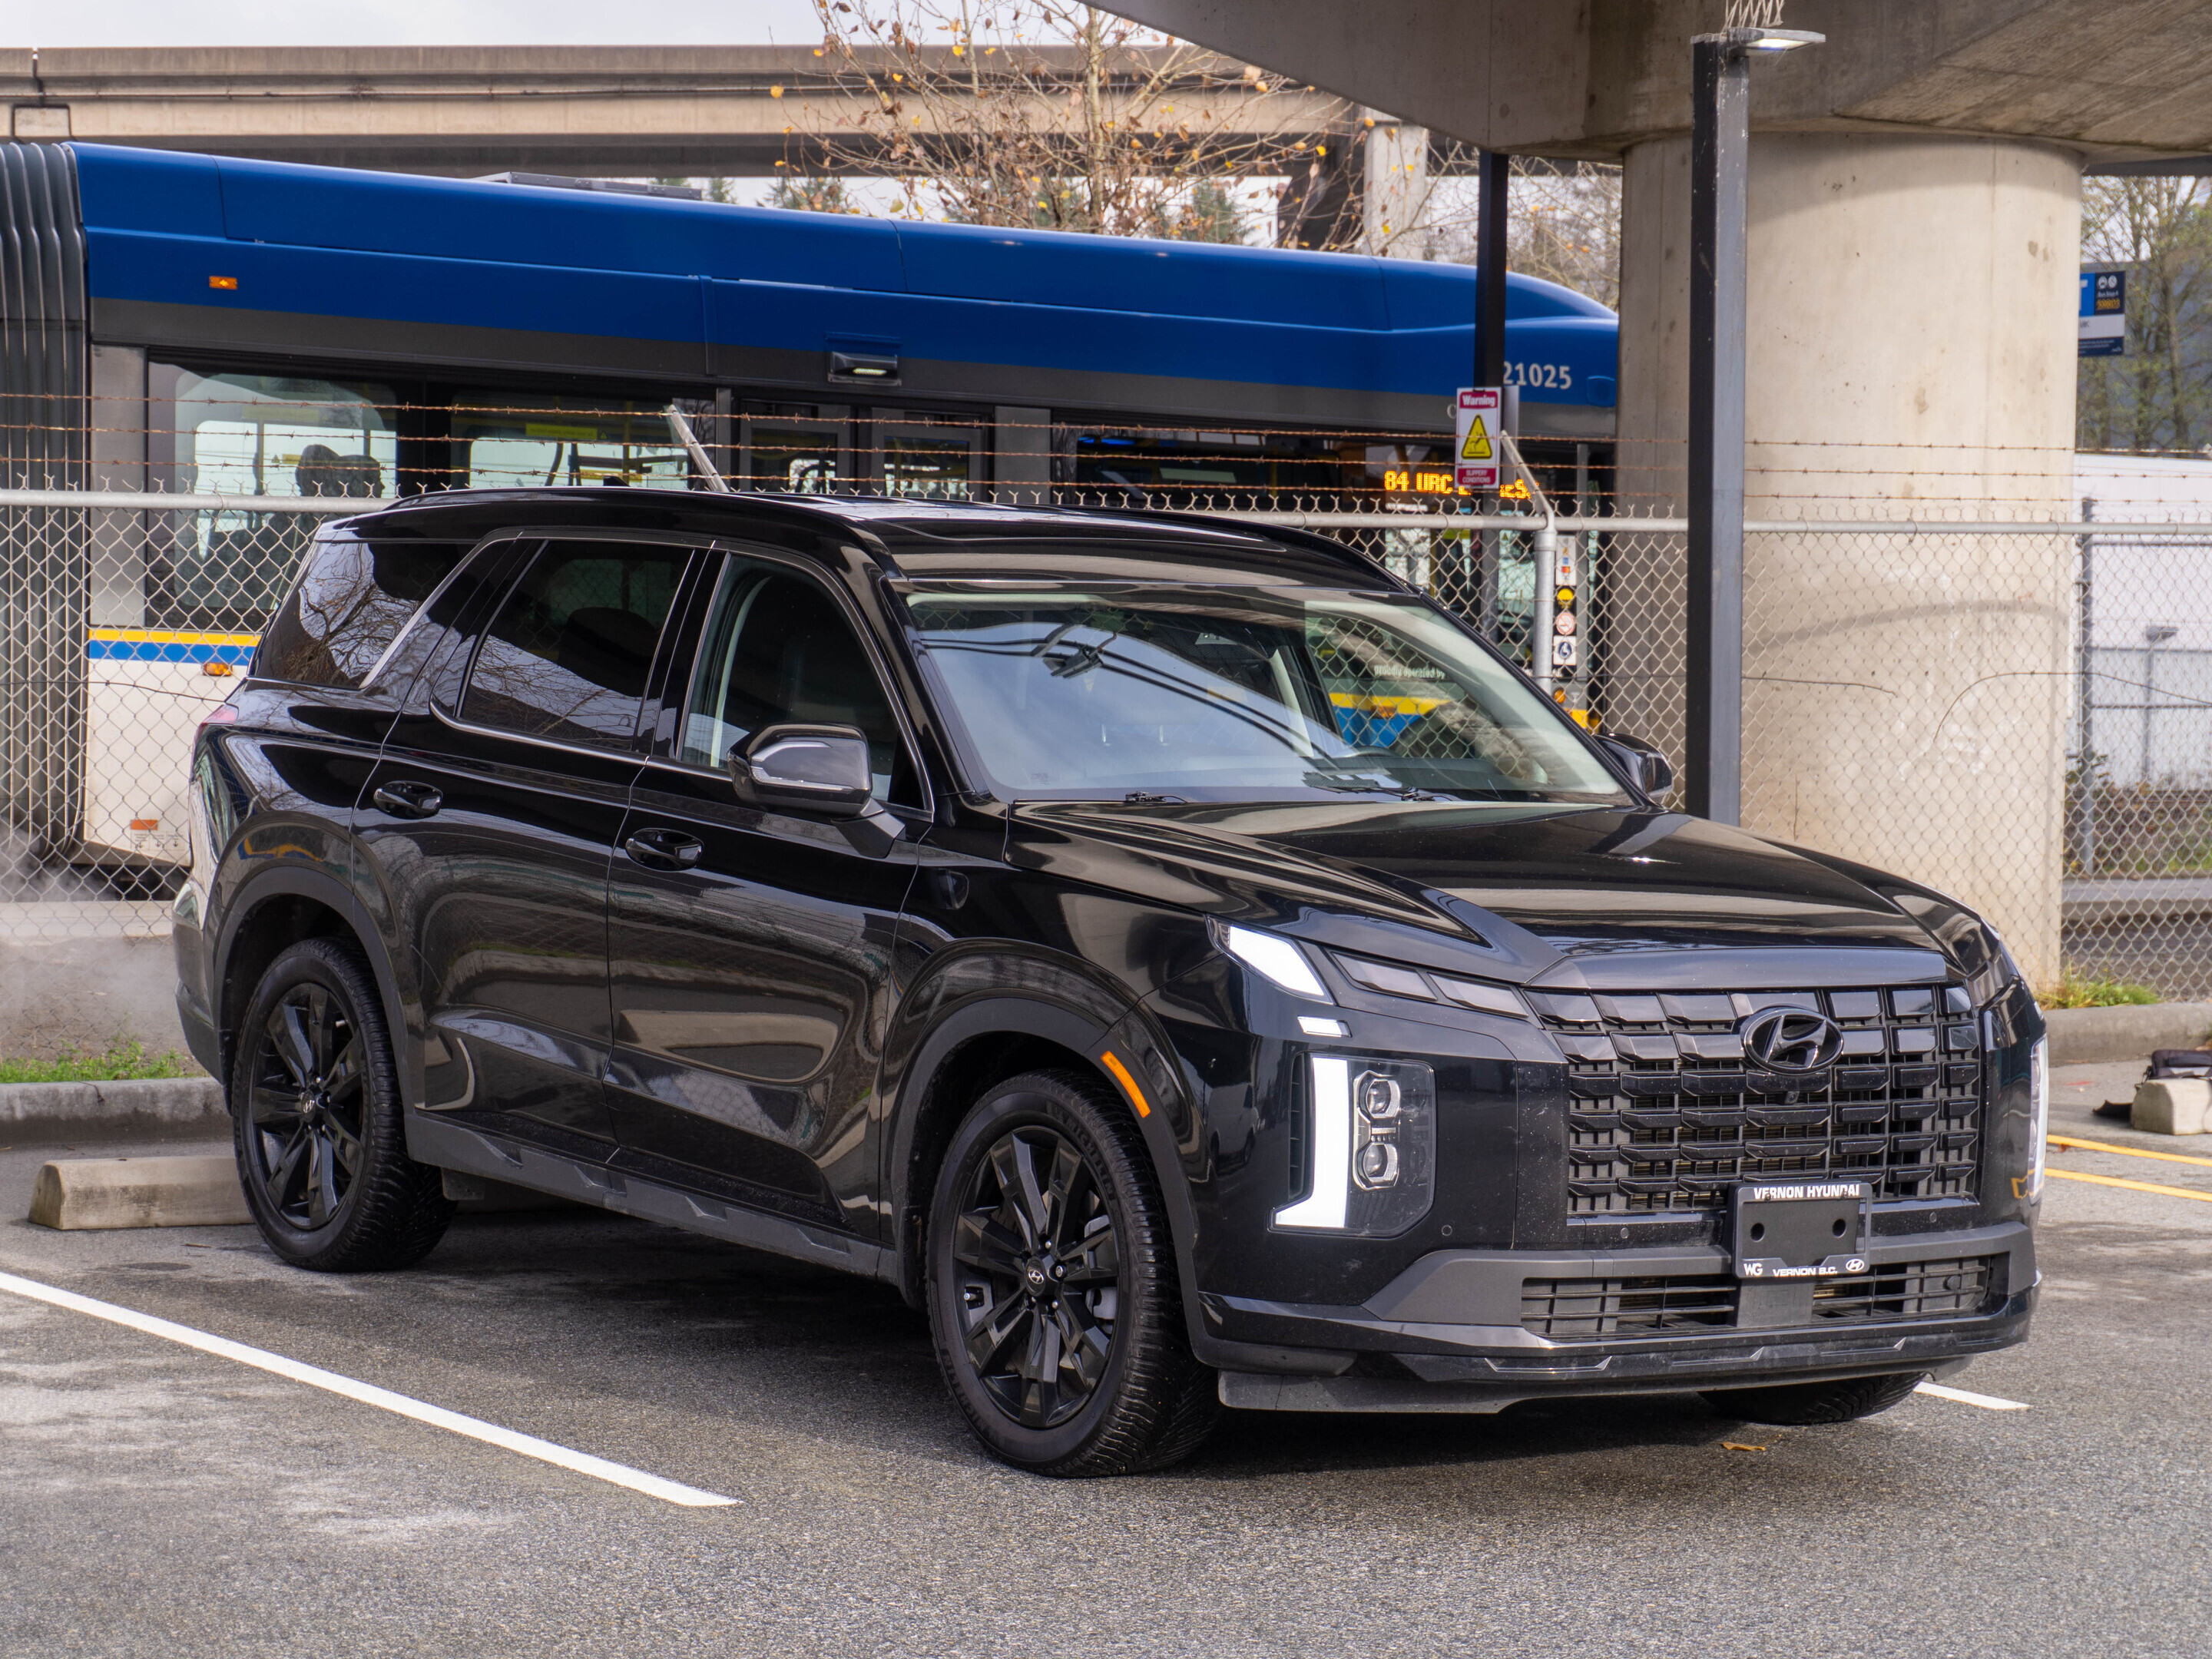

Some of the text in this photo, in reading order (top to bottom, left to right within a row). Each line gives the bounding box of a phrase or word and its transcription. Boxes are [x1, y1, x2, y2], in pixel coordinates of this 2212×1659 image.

[1503, 361, 1572, 389] 21025
[1462, 395, 1496, 407] Warning
[1384, 471, 1410, 492] 84
[1065, 1116, 1114, 1194] MICHELIN
[1753, 1186, 1803, 1200] VERNON
[1743, 1263, 1763, 1277] WG
[1772, 1266, 1838, 1277] VERNON B.C.
